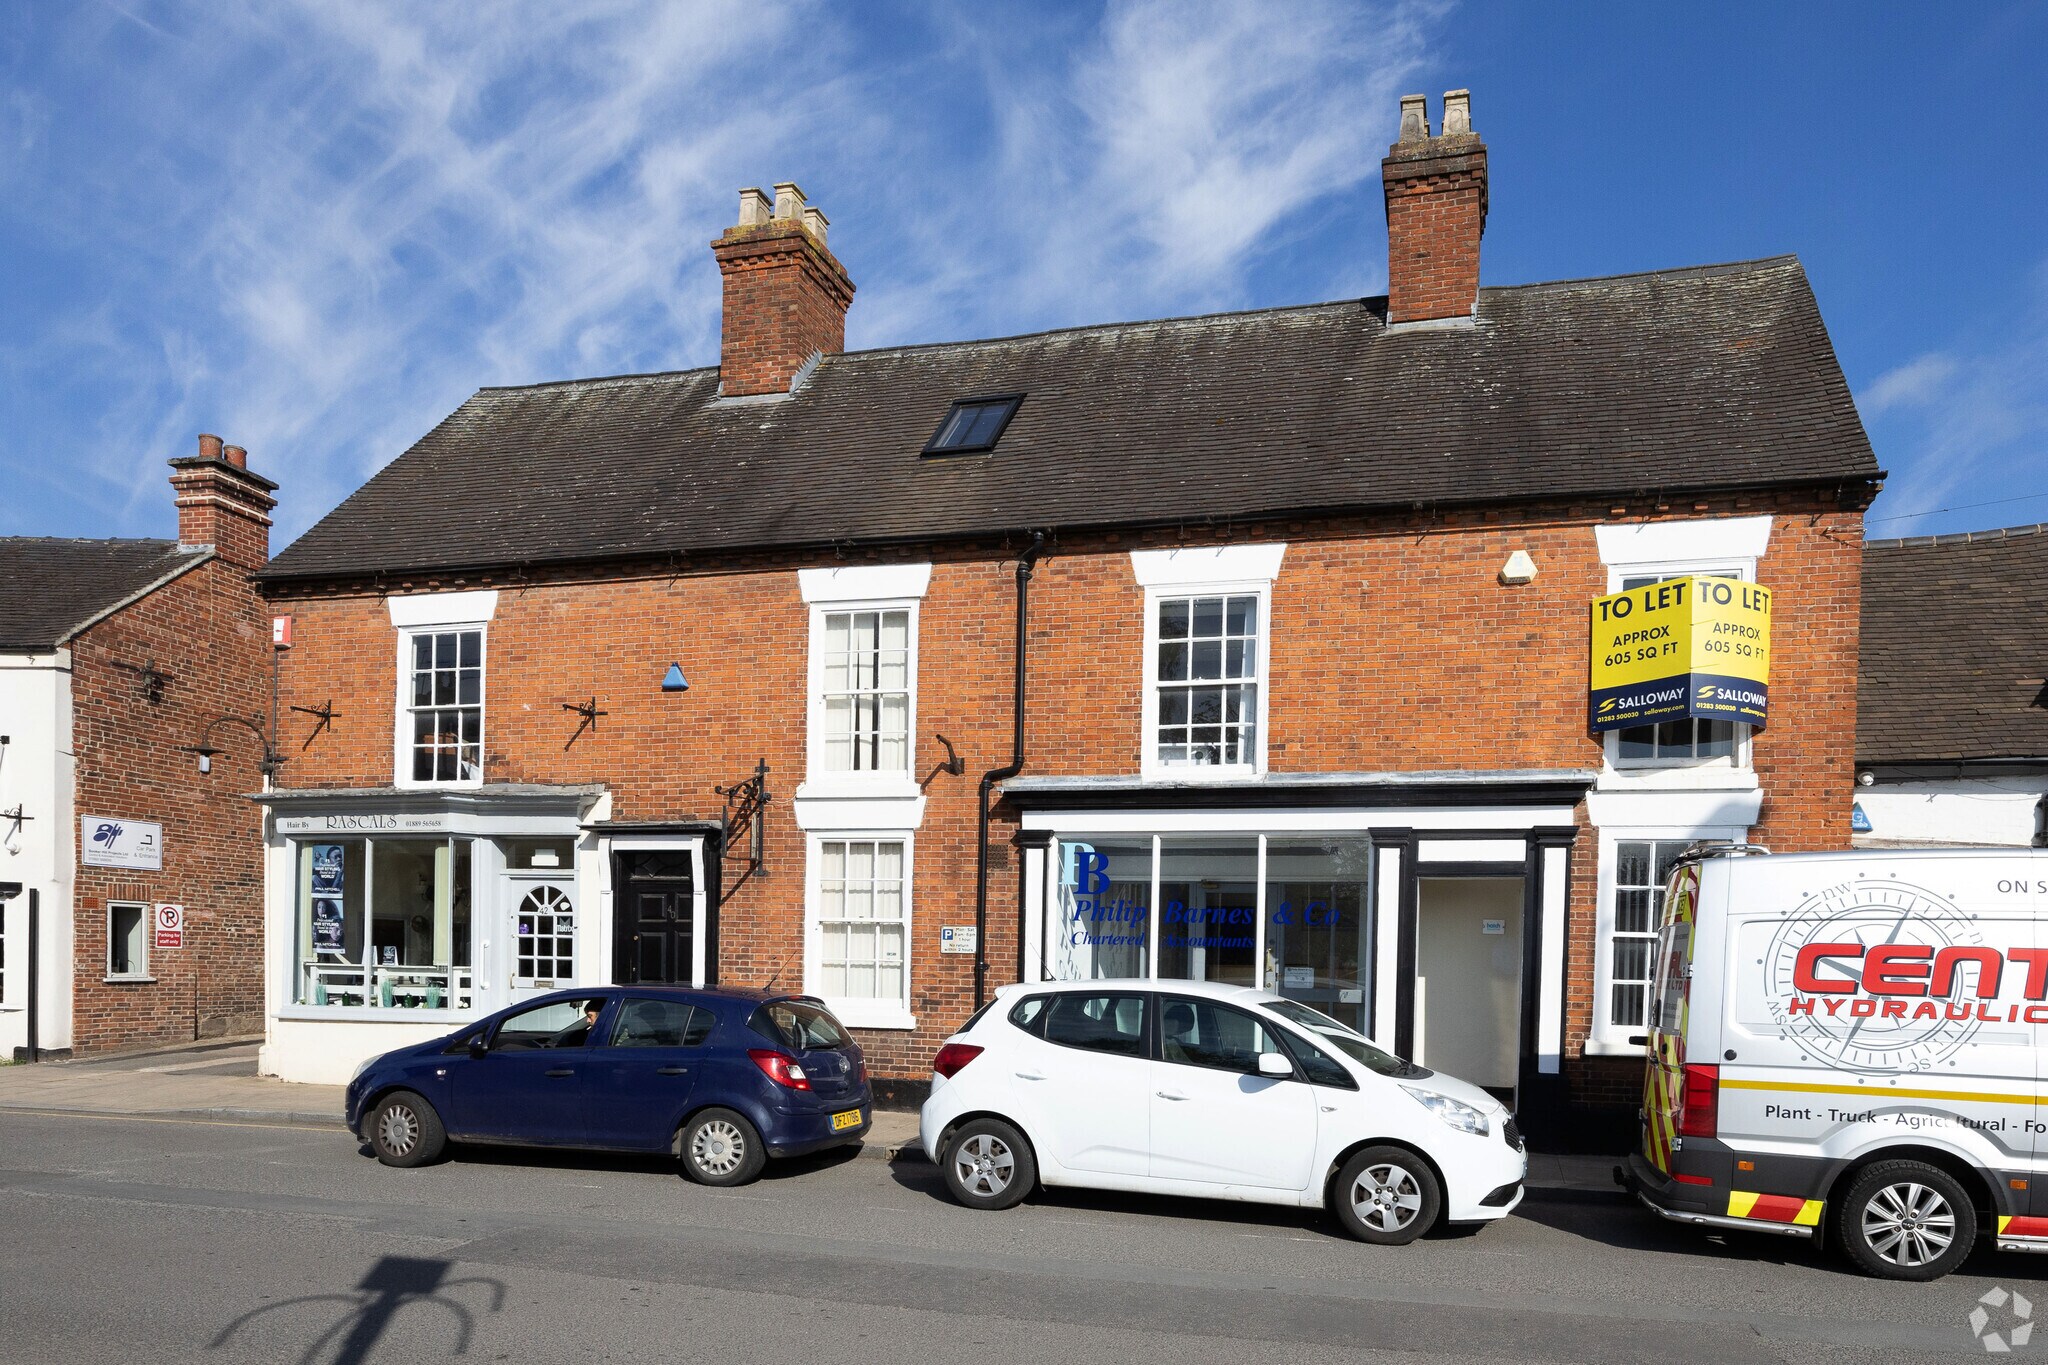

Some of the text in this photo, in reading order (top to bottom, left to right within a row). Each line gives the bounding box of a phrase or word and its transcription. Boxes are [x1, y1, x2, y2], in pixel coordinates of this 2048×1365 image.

[1599, 583, 1686, 621] TO LET
[1699, 582, 1769, 614] TO LET
[1612, 625, 1670, 648] APPROX
[1713, 622, 1761, 640] APPROX
[1605, 642, 1678, 667] 605 SQ FT
[1704, 640, 1765, 660] 605 SQ FT
[1618, 688, 1685, 709] SALLOWAY
[1696, 701, 1714, 710] 01283
[1714, 703, 1737, 712] 500030
[1717, 688, 1767, 707] SALLOWAY
[1596, 704, 1685, 723] 01283 500030 salloway.com
[302, 822, 309, 830] By
[326, 814, 397, 829] RASCALS
[1997, 879, 2028, 894] ON
[540, 906, 549, 915] 42
[1072, 900, 1341, 928] Philip Barnes & Co
[1071, 931, 1255, 948] Chartered Accountants
[1765, 1105, 1811, 1120] Plant
[1828, 1109, 1876, 1124] Truck
